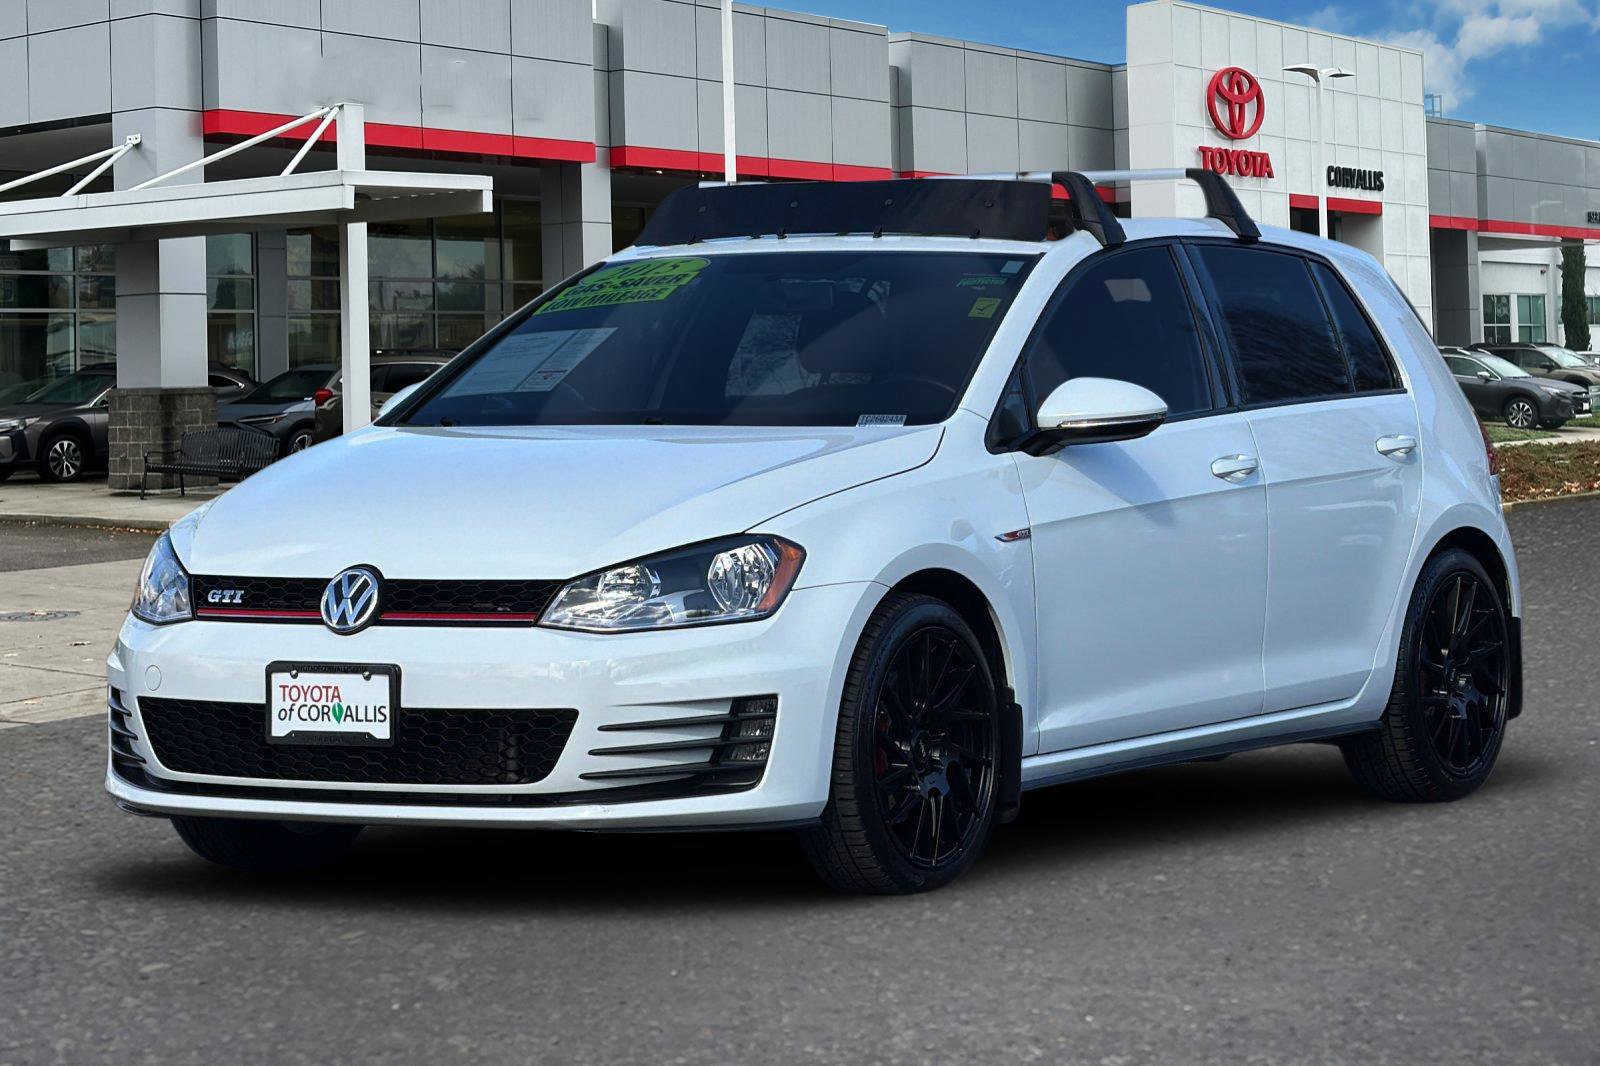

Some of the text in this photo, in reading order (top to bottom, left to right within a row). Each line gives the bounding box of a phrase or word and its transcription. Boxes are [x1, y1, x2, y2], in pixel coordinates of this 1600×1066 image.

[1198, 146, 1274, 178] TOYOTA
[1327, 165, 1384, 191] CORVALLIS
[207, 589, 245, 604] GTI
[279, 684, 342, 703] TOYOTA
[278, 703, 296, 721] of
